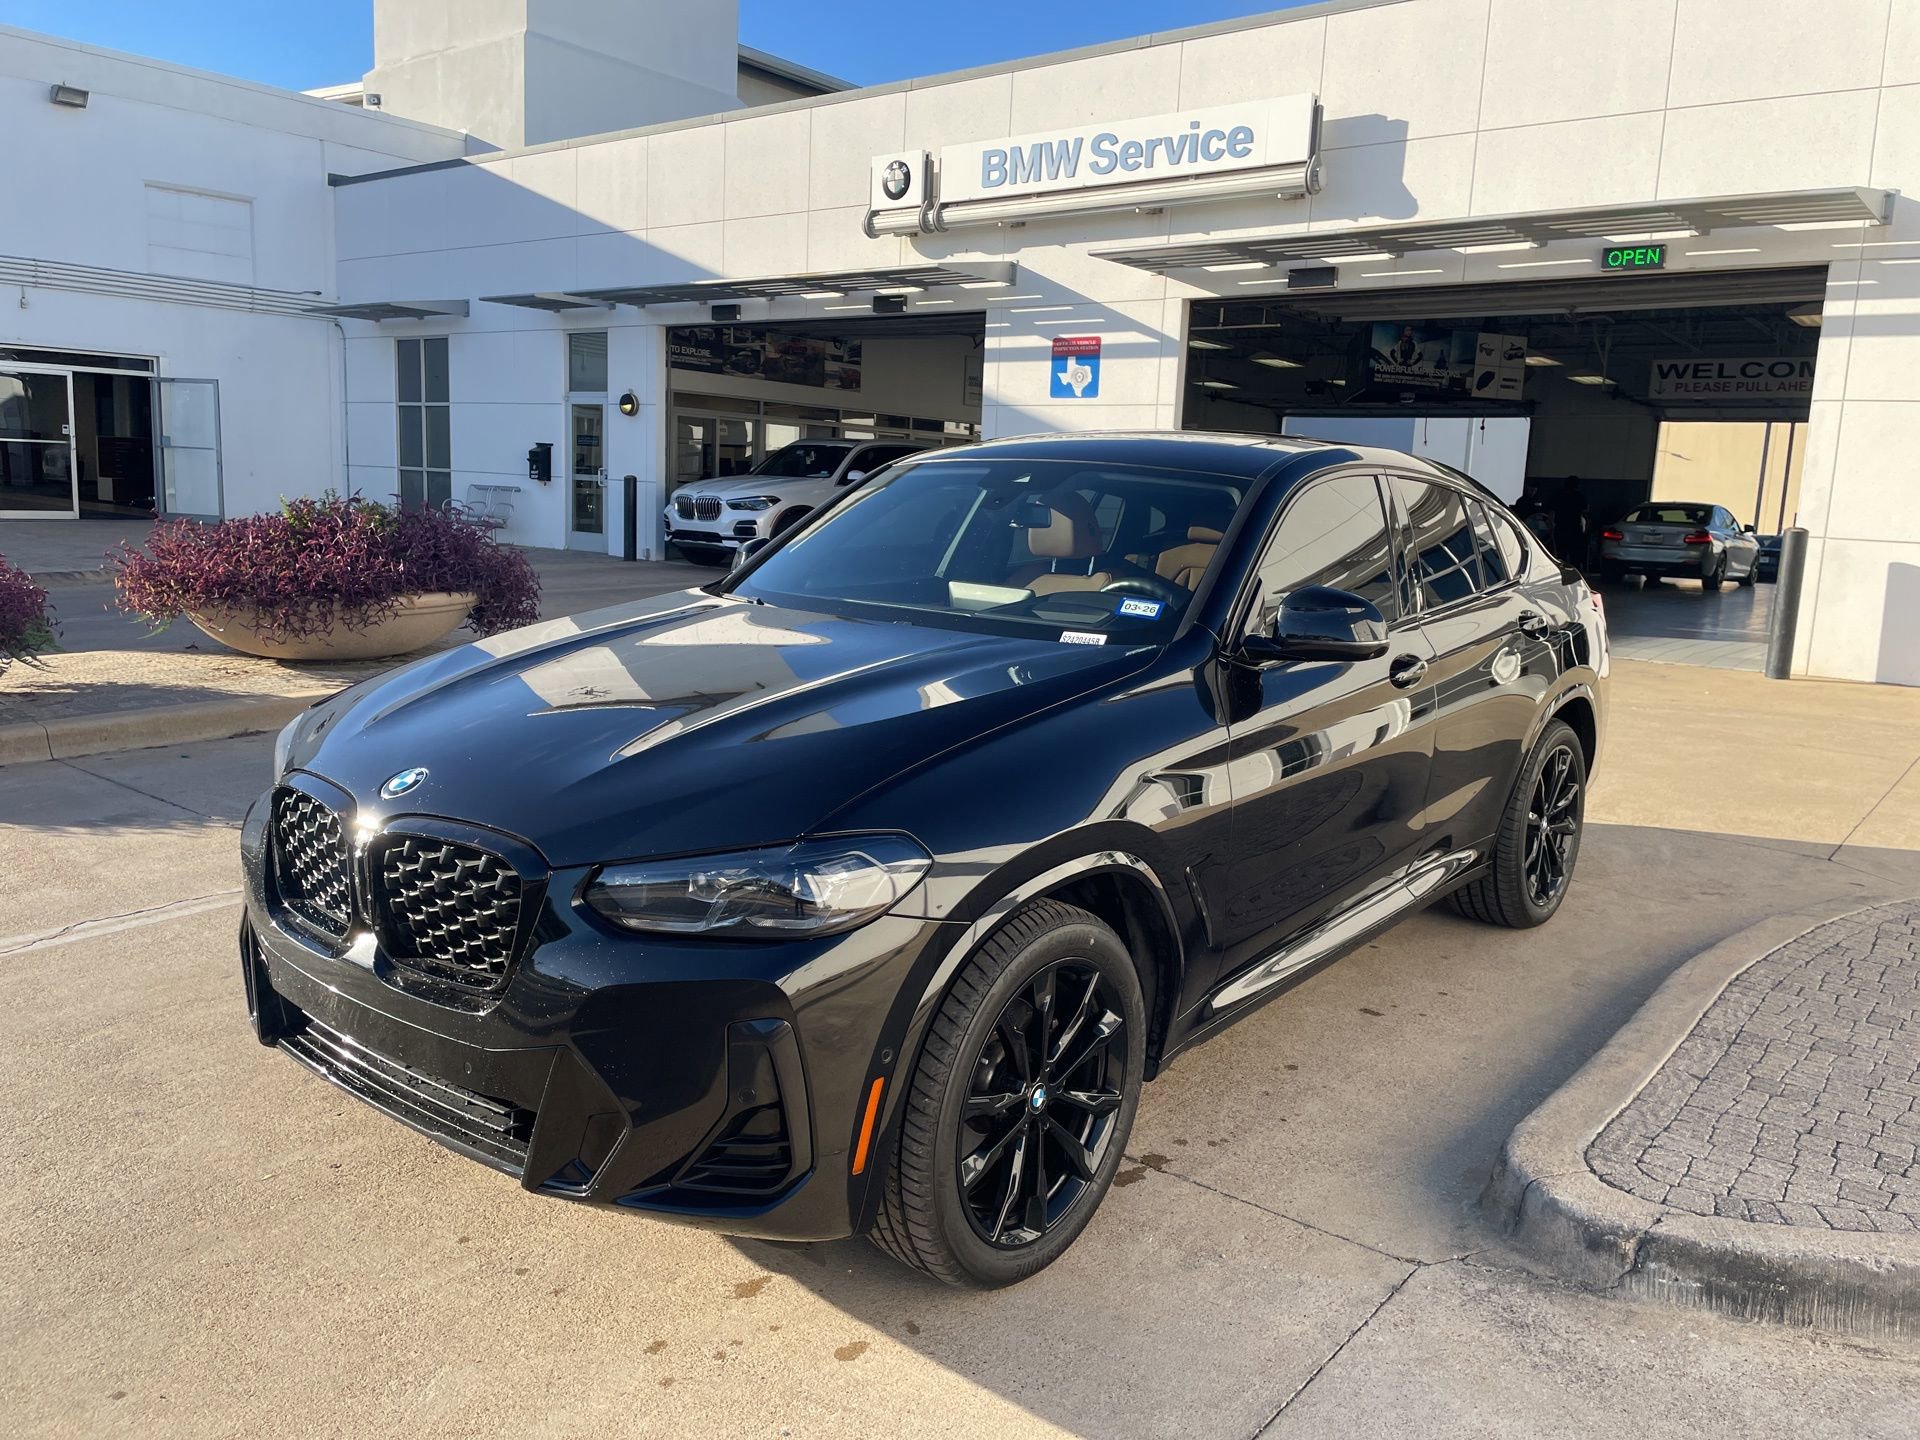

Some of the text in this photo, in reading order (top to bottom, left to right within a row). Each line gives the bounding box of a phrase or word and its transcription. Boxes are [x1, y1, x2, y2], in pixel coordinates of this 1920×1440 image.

[981, 120, 1254, 188] BMW Service
[1608, 248, 1660, 267] OPEN
[1674, 381, 1731, 393] PLEASE
[1735, 381, 1772, 392] PULL
